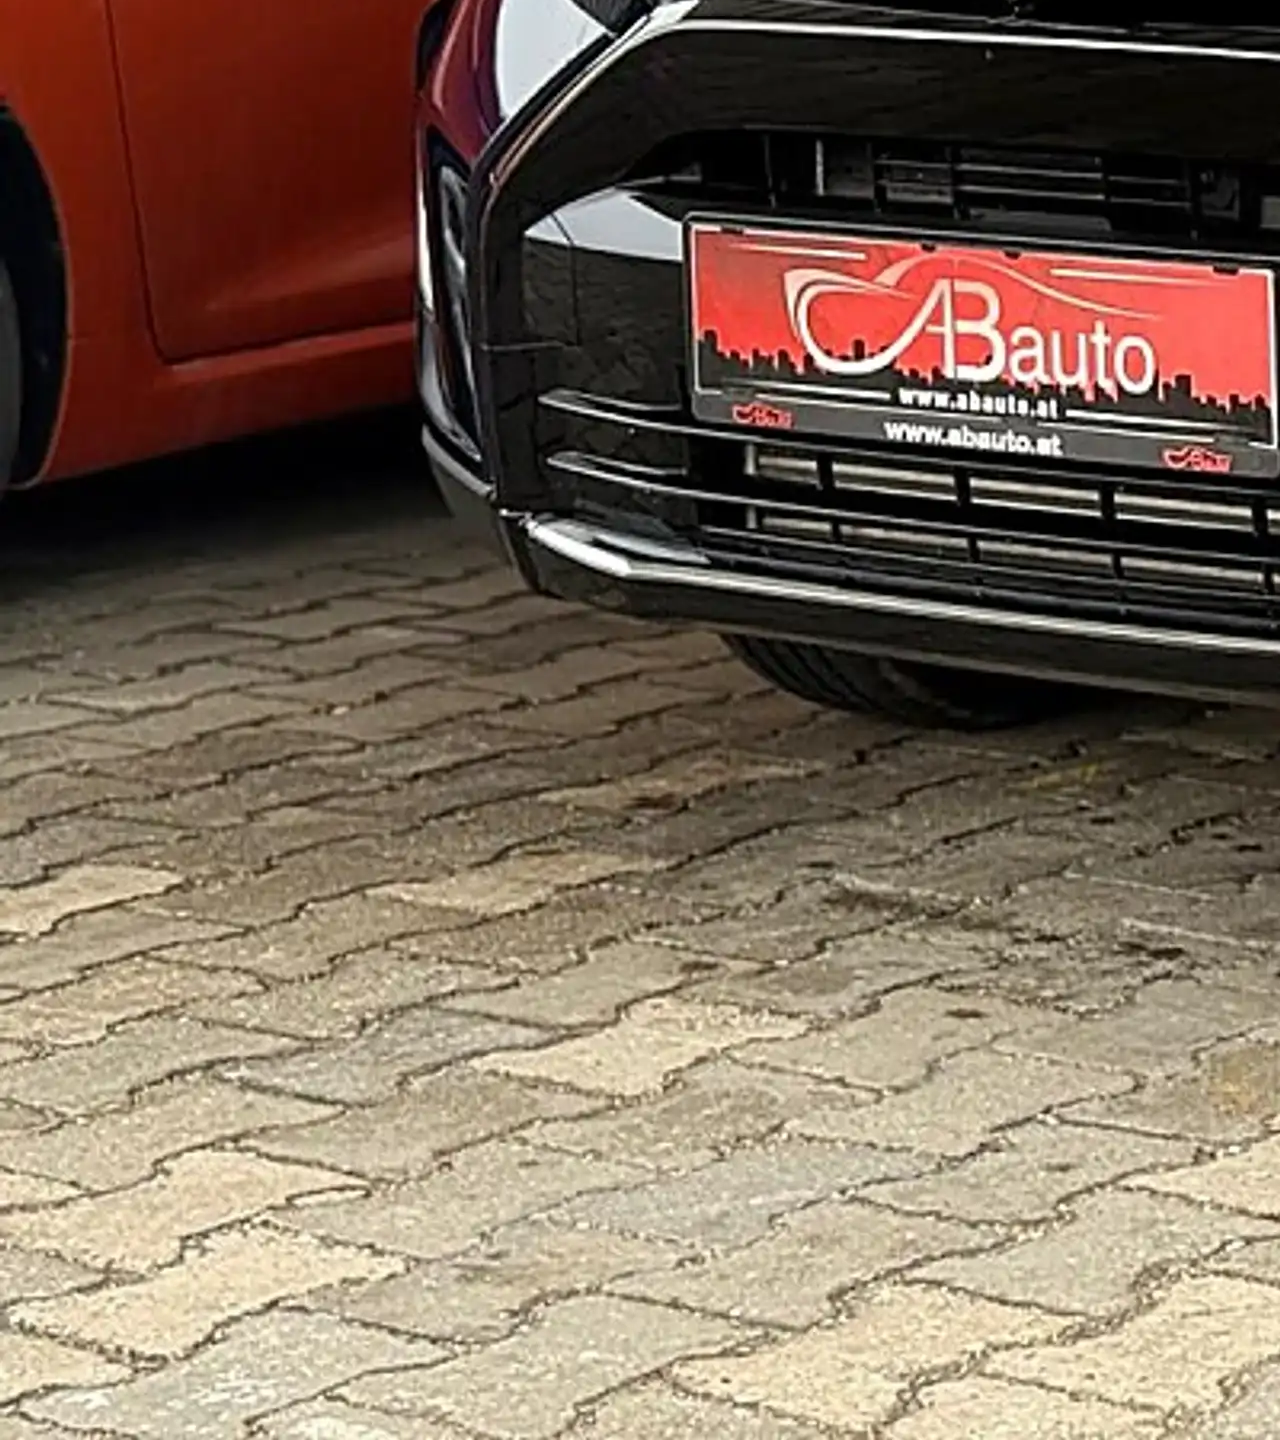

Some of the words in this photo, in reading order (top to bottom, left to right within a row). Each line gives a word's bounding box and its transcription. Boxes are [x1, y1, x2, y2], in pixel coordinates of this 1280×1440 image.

[895, 277, 1157, 394] ABauto
[898, 387, 1059, 420] www.abauto.at
[883, 420, 1063, 456] www.abauto.at
